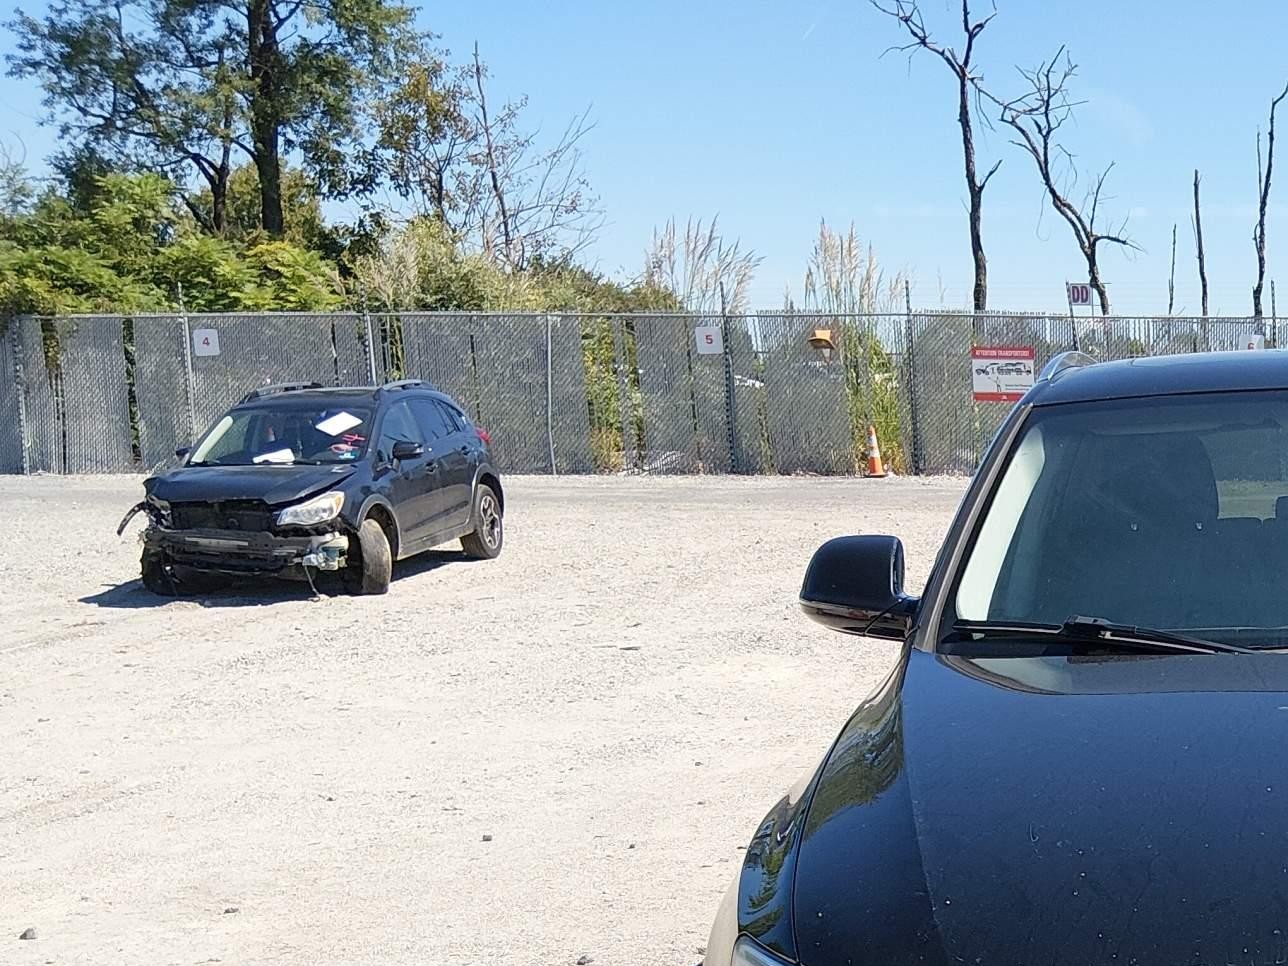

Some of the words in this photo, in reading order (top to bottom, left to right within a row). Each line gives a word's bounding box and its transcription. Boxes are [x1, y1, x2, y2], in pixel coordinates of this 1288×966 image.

[1072, 285, 1089, 303] DD
[202, 336, 210, 346] 4
[705, 334, 714, 345] 5
